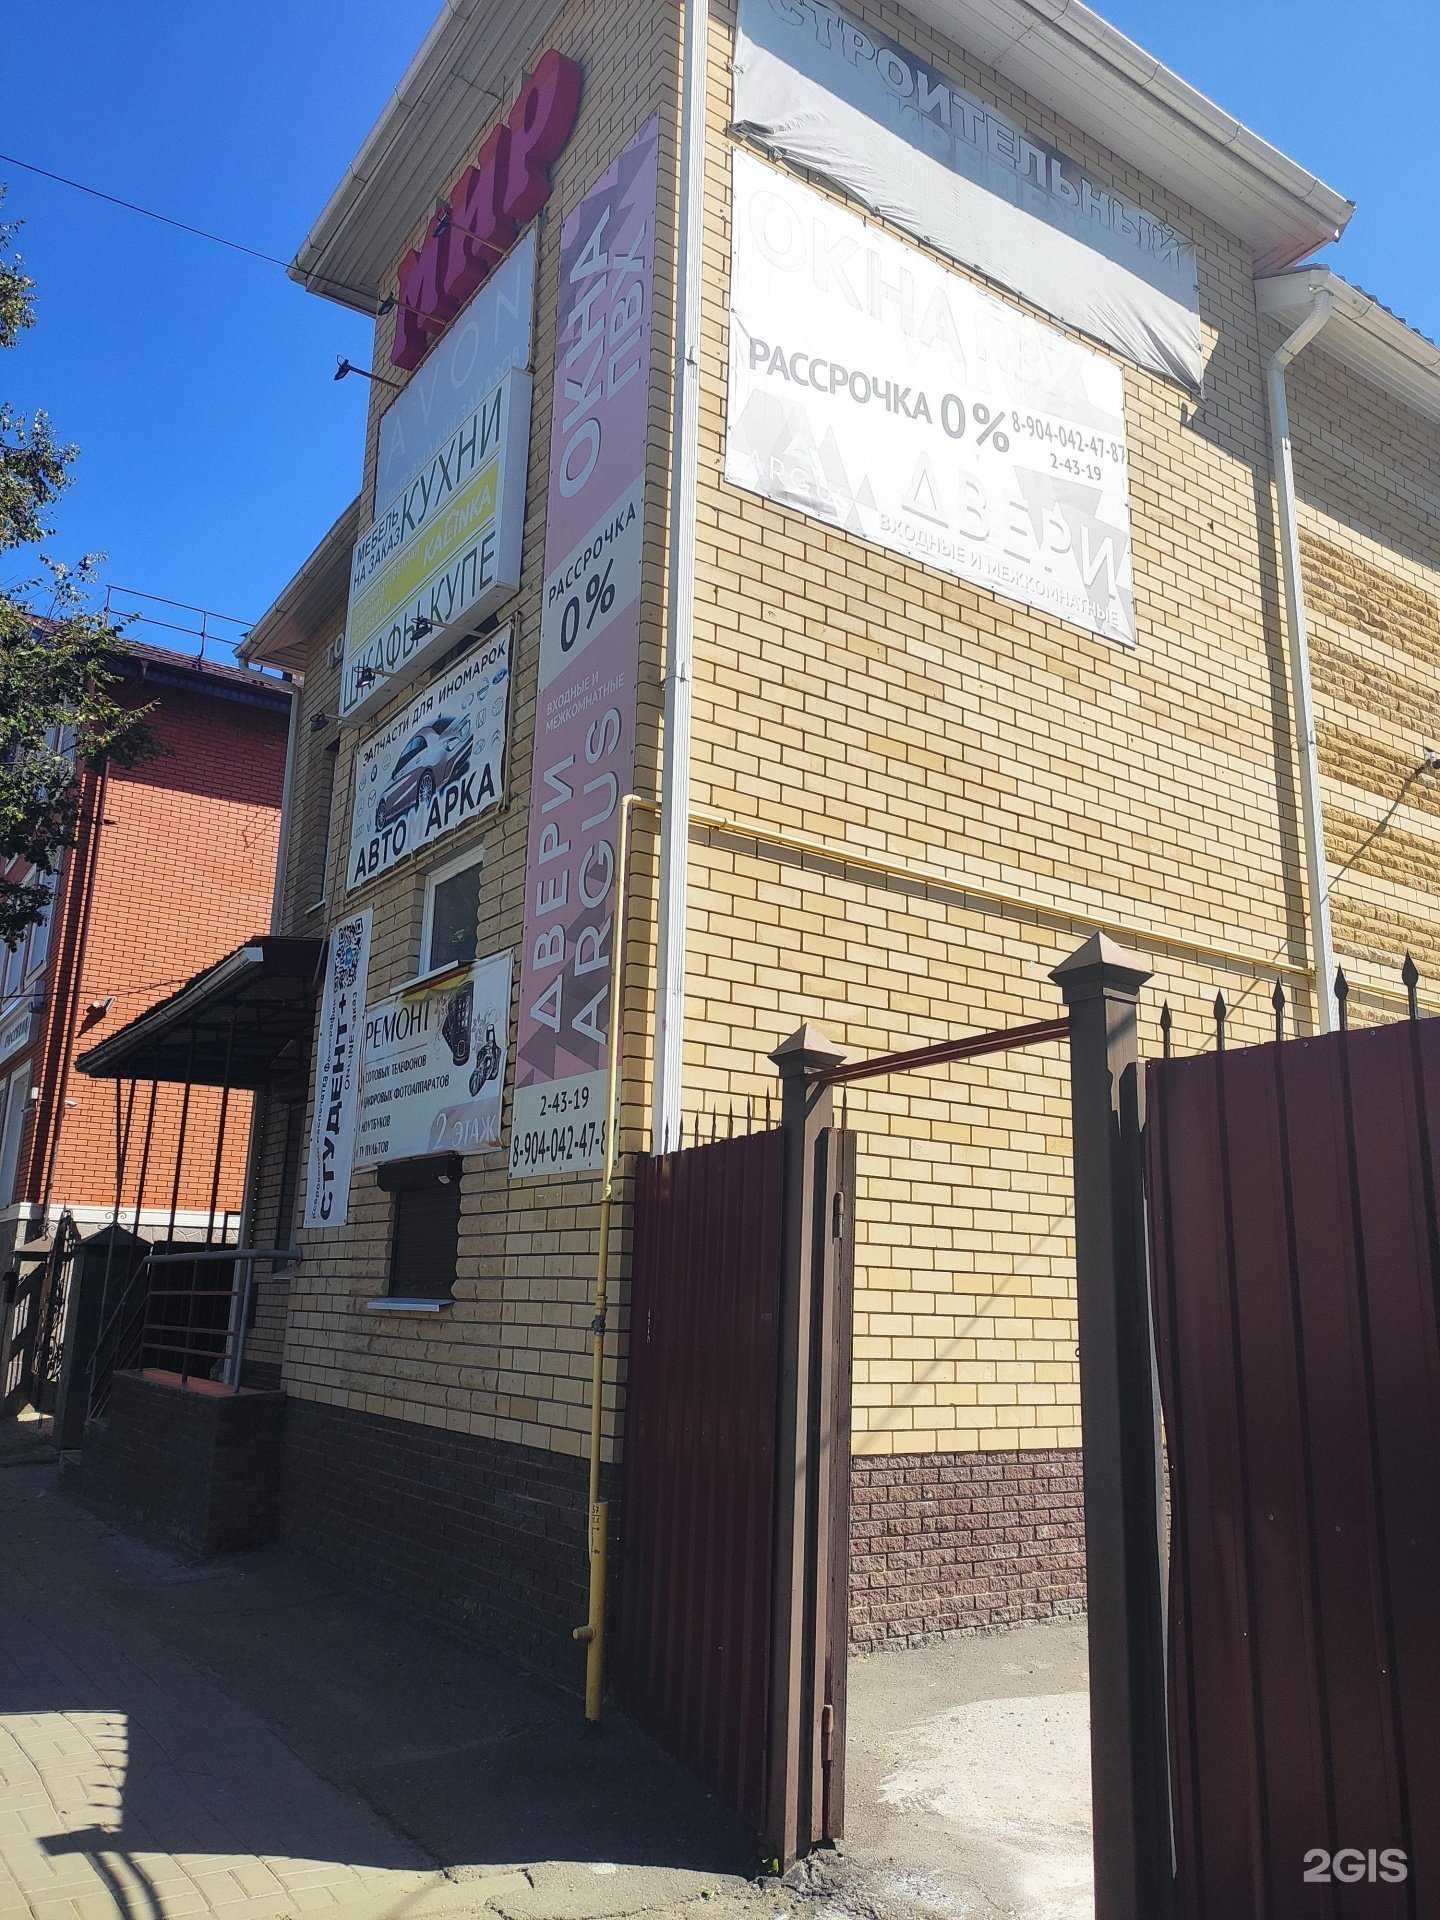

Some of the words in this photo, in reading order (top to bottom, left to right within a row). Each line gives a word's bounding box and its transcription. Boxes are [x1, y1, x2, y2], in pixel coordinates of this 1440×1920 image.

[391, 48, 583, 371] МИР
[559, 204, 610, 497] ОКНА
[607, 220, 647, 402] ПВХ
[385, 262, 522, 477] AVON
[748, 337, 932, 425] РАССРОЧКА
[400, 386, 503, 543] КУХНИ
[1011, 410, 1127, 465] 8-904-042-47-87
[1050, 452, 1103, 482] 2-43-19
[352, 570, 368, 592] НА
[367, 532, 402, 577] ЗАКАЗ
[357, 510, 399, 557] МЕБЕЛЬ
[548, 501, 637, 609] РАССРОЧКА
[879, 512, 965, 563] ВХОДНЫЕ
[343, 600, 421, 713] ШКАФЫ
[430, 529, 497, 623] КУПЕ
[362, 720, 410, 767] ЗАПЧАСТИ
[412, 695, 434, 728] ДЛЯ
[438, 639, 507, 704] ИНОМАРОК
[544, 672, 625, 735] МЕЖКОМНАТНЫЕ
[546, 676, 591, 716] ВХОДНЫЕ
[530, 753, 575, 1033] ДВЕРИ
[571, 705, 622, 1045] ARGUS
[393, 1074, 450, 1100] ФОТОАППАРАТОВ
[540, 1086, 589, 1117] 2-43-19
[432, 1112, 447, 1151] 2
[453, 1113, 497, 1148] ЭТАЖ
